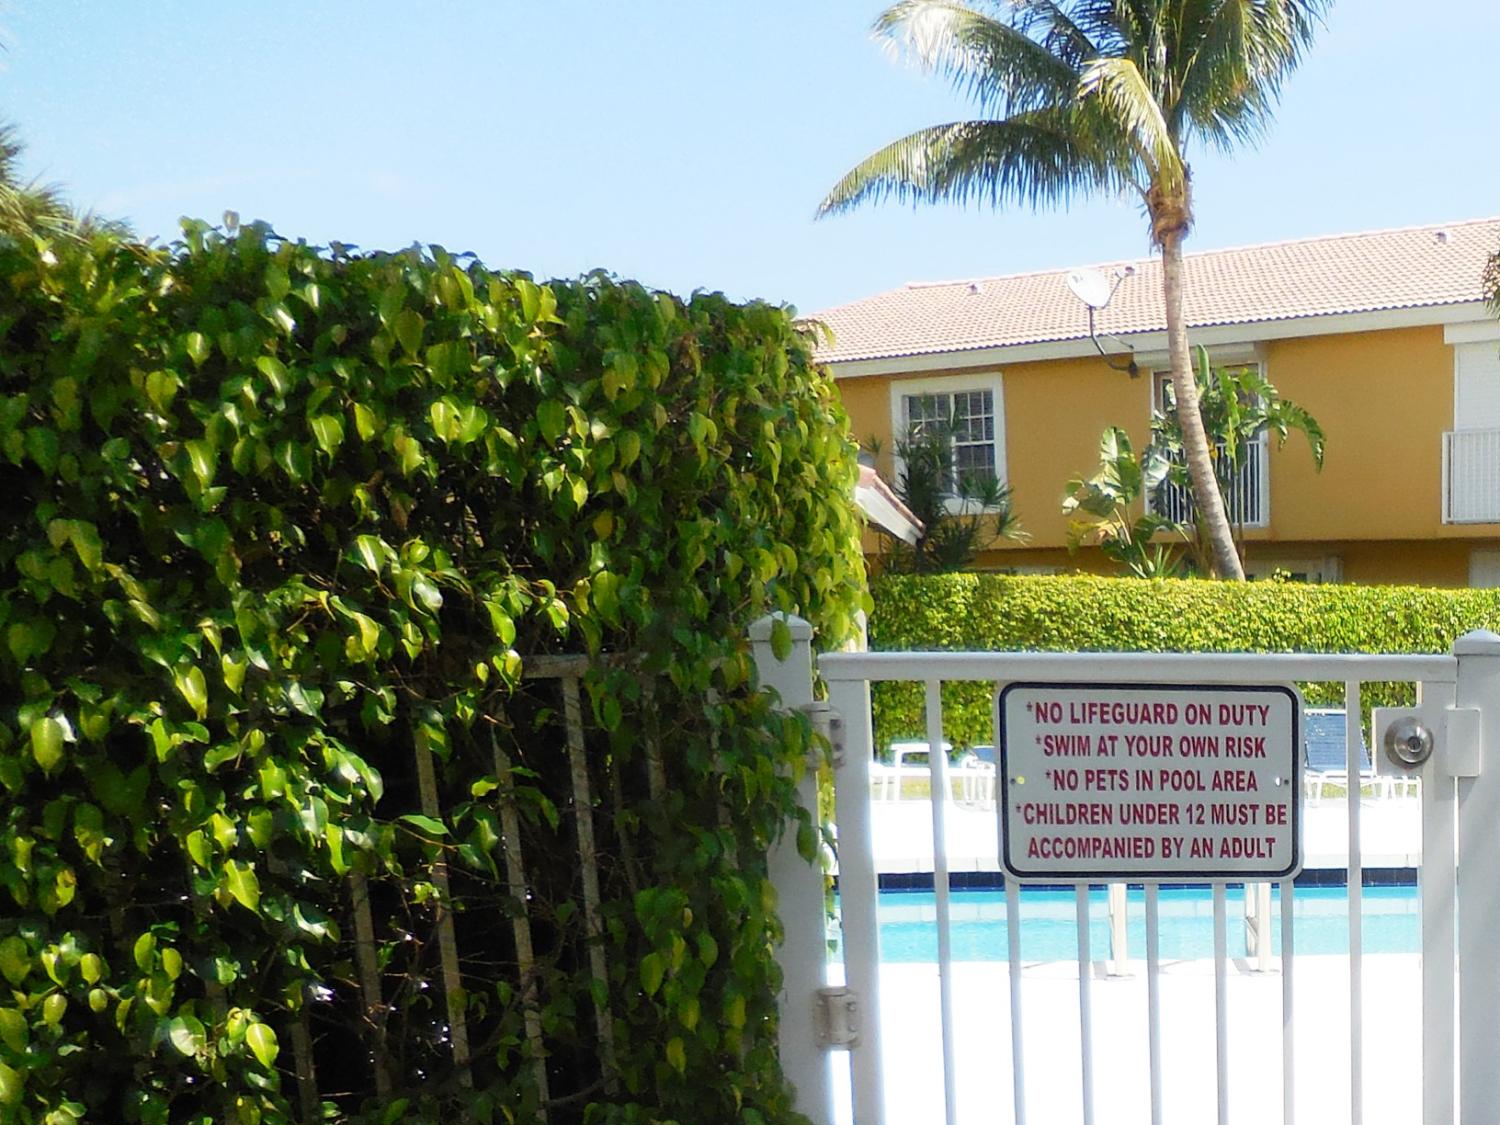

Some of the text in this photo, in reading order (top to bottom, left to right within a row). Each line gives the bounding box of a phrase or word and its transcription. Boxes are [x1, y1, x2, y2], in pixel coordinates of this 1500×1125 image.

[1070, 702, 1178, 724] LIFEGUARD
[1185, 703, 1211, 725] ON
[1220, 705, 1270, 726] DUTY
[1097, 736, 1119, 756] AT
[1125, 736, 1172, 757] YOUR
[1179, 736, 1219, 757] OWN
[1225, 737, 1266, 758] RISK
[1086, 770, 1129, 791] PETS
[1136, 770, 1153, 791] IN
[1161, 770, 1205, 791] POOL
[1212, 771, 1257, 791] AREA
[1120, 804, 1179, 825] UNDER
[1186, 804, 1204, 825] 12
[1212, 804, 1259, 825] MUST
[1266, 805, 1287, 825] BE
[1028, 837, 1275, 859] ACCOMPANIED BY AN ADULT
